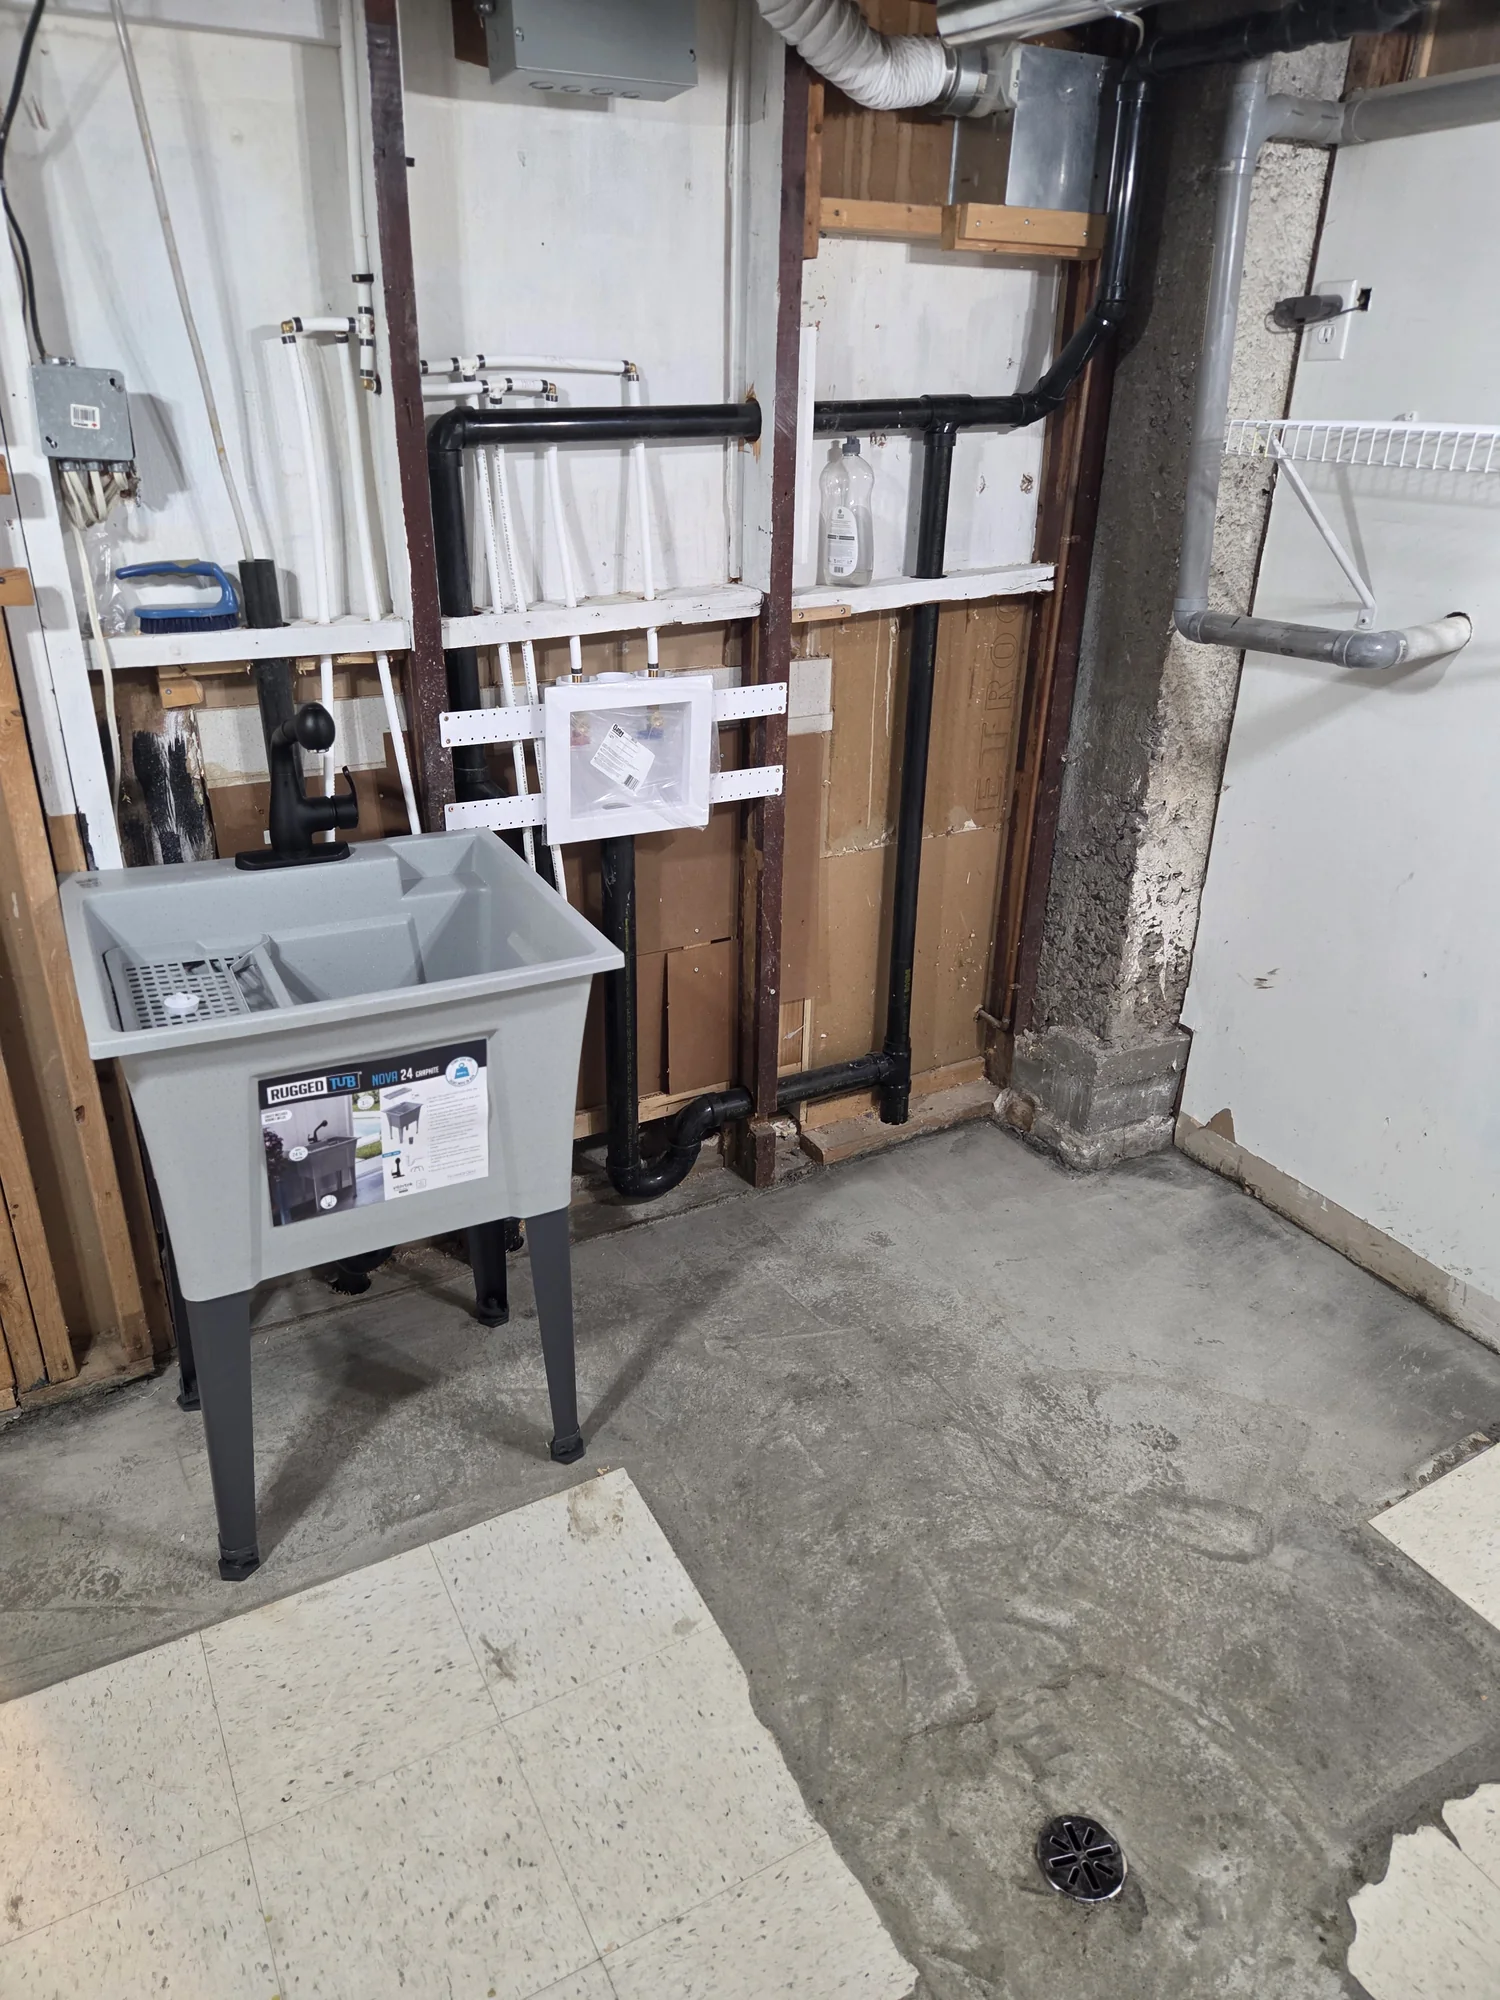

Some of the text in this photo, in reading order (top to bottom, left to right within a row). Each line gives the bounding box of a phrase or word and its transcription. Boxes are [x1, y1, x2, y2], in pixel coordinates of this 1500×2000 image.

[271, 1066, 439, 1100] RUGGED TUB NOVA 24 GRAPHITE
